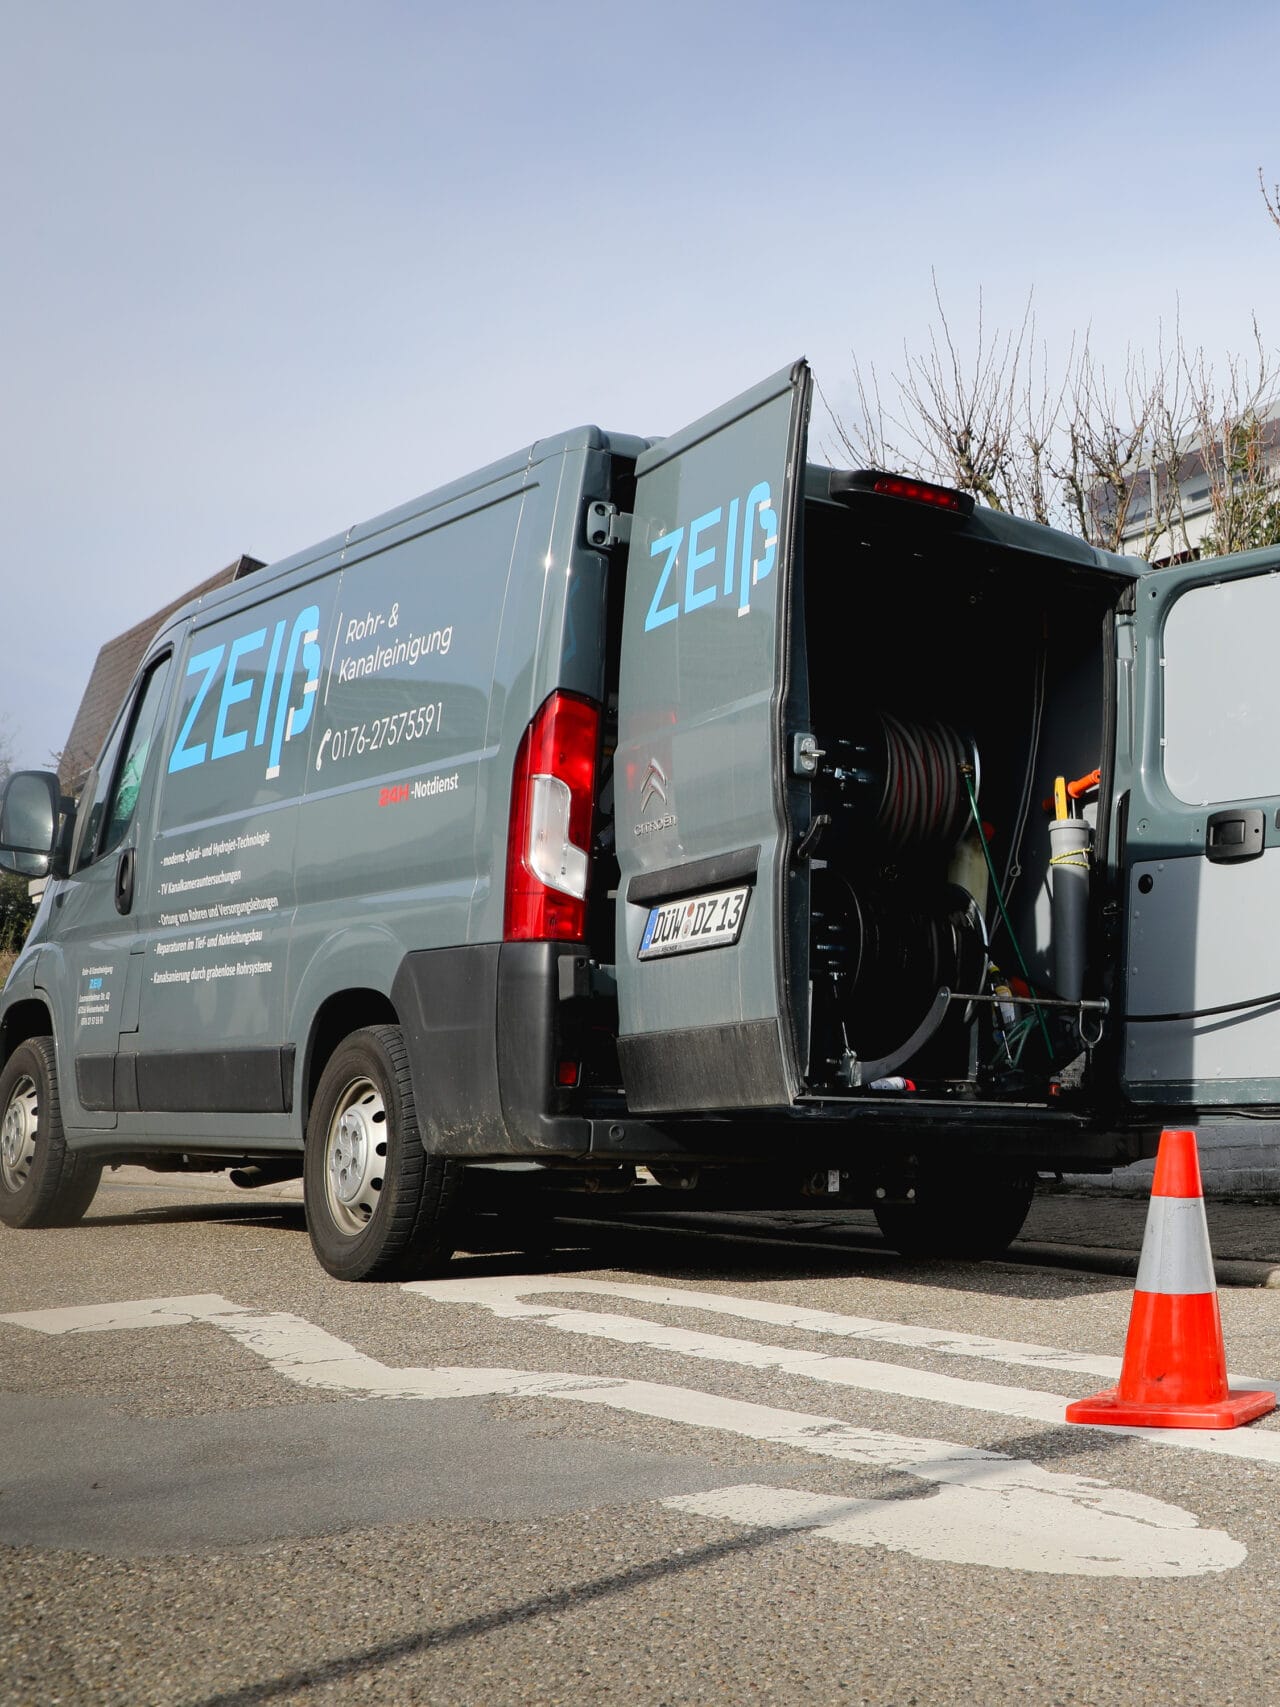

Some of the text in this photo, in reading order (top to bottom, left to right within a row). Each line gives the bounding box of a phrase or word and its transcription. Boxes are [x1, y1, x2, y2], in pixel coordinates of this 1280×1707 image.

[345, 602, 399, 645] Rohr- &
[338, 625, 453, 684] Kanalreinigung
[331, 702, 443, 761] 0176-27575591
[378, 784, 410, 807] 24H
[201, 843, 213, 857] und
[161, 884, 168, 896] TV
[179, 912, 188, 922] von
[188, 908, 208, 921] Rohren
[208, 904, 219, 918] und
[651, 895, 744, 944] DÜW DZ 13
[206, 933, 218, 948] und
[191, 966, 206, 980] durch
